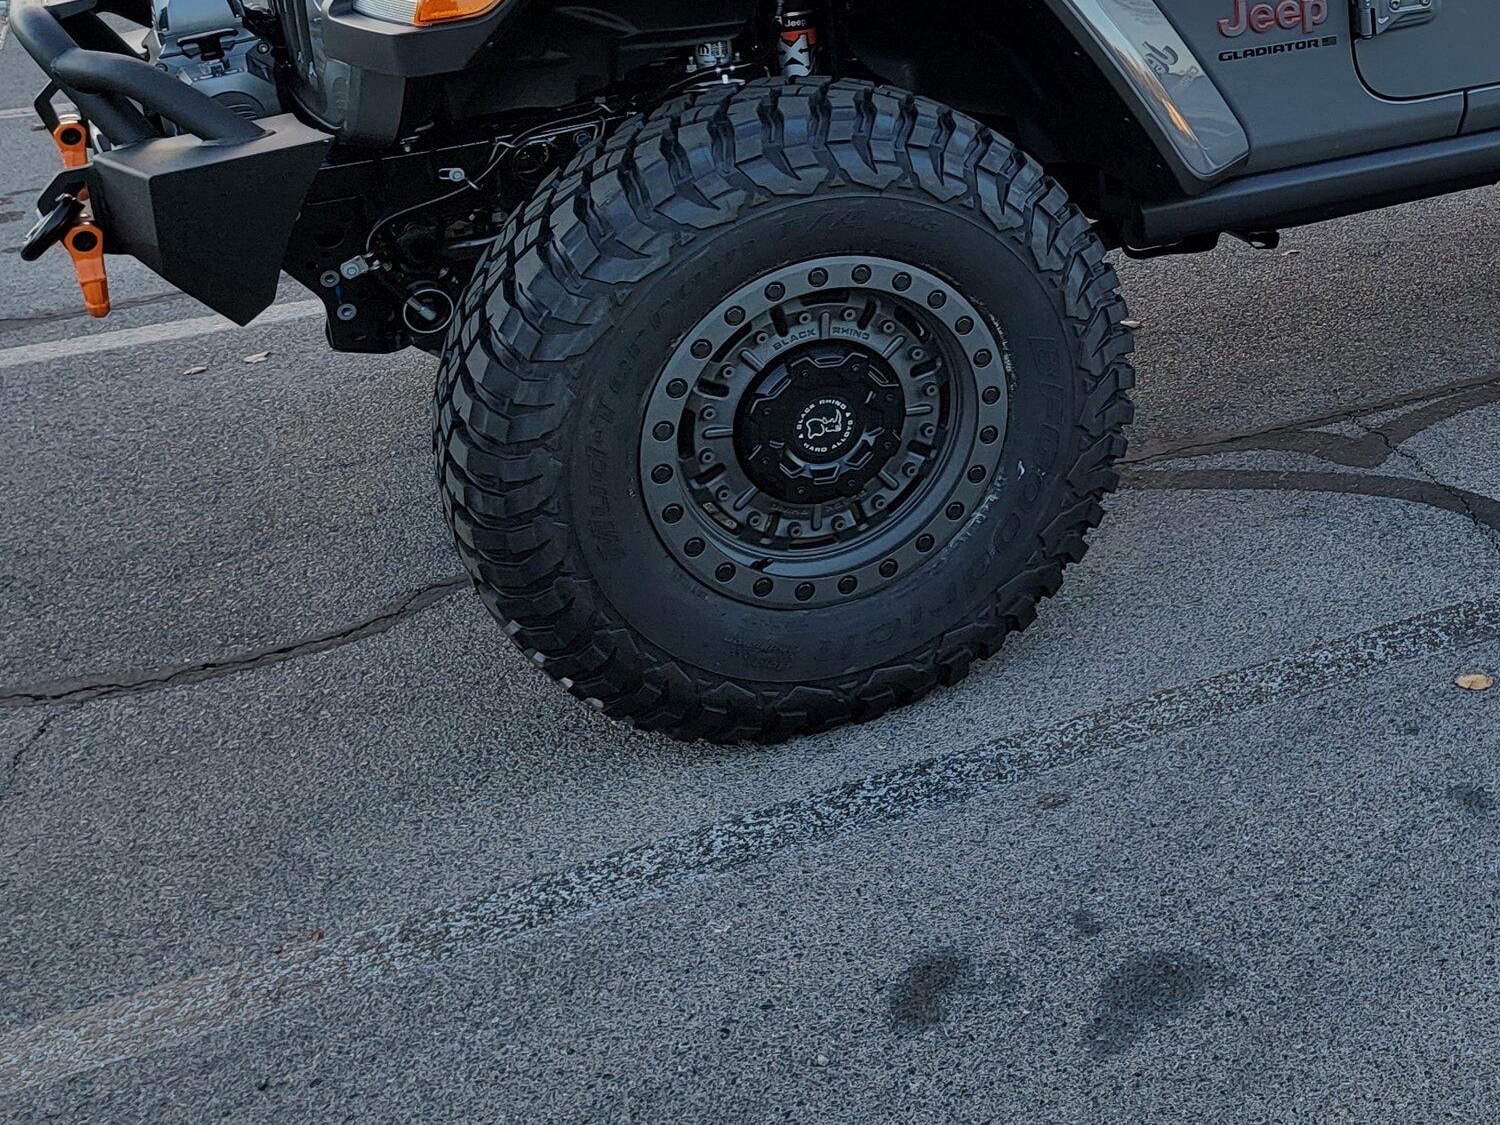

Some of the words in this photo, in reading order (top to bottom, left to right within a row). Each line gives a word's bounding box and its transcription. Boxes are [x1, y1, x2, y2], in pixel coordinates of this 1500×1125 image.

[783, 18, 808, 28] Jeep
[1217, 38, 1320, 63] GLADIATOR
[772, 328, 816, 351] BLACK
[831, 326, 871, 341] RHINO
[795, 403, 817, 431] BLACK
[818, 398, 848, 411] RHINO
[802, 442, 828, 453] HARD
